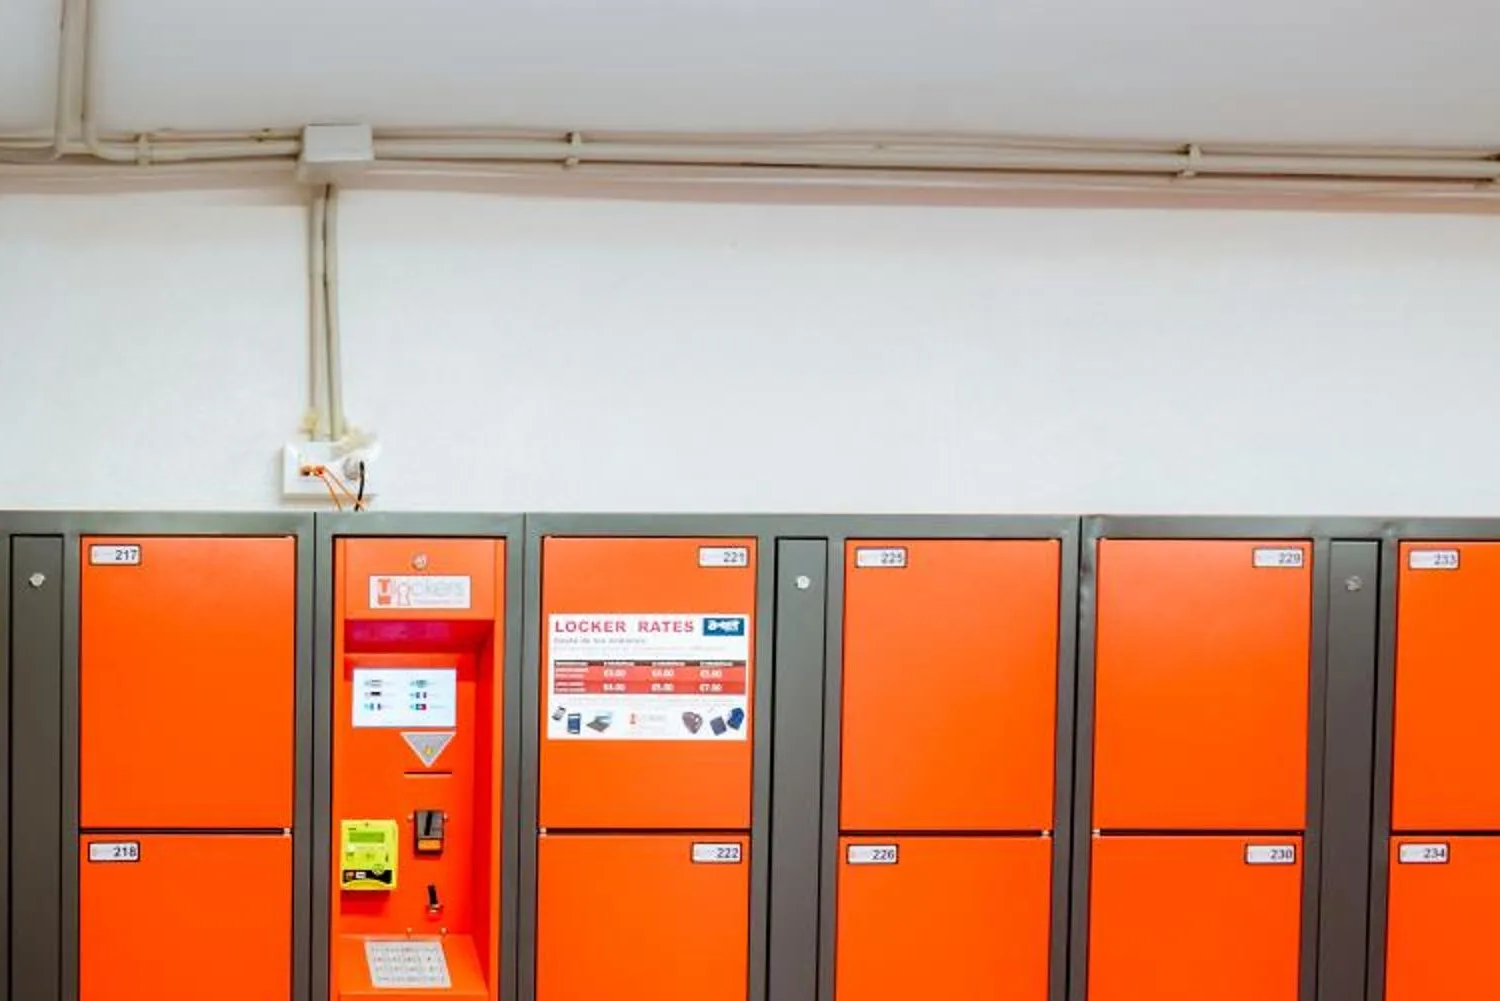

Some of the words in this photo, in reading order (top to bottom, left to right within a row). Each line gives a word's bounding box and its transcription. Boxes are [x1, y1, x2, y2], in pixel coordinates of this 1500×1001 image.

[115, 549, 137, 561] 217
[723, 552, 744, 563] 221
[881, 553, 903, 564] 225
[1278, 553, 1300, 564] 229
[1434, 554, 1456, 565] 233
[555, 620, 627, 633] LOCKER
[638, 620, 694, 633] RATES
[113, 847, 136, 857] 218
[716, 847, 738, 858] 222
[872, 849, 894, 860] 226
[1270, 849, 1292, 860] 230
[1424, 848, 1445, 859] 234
